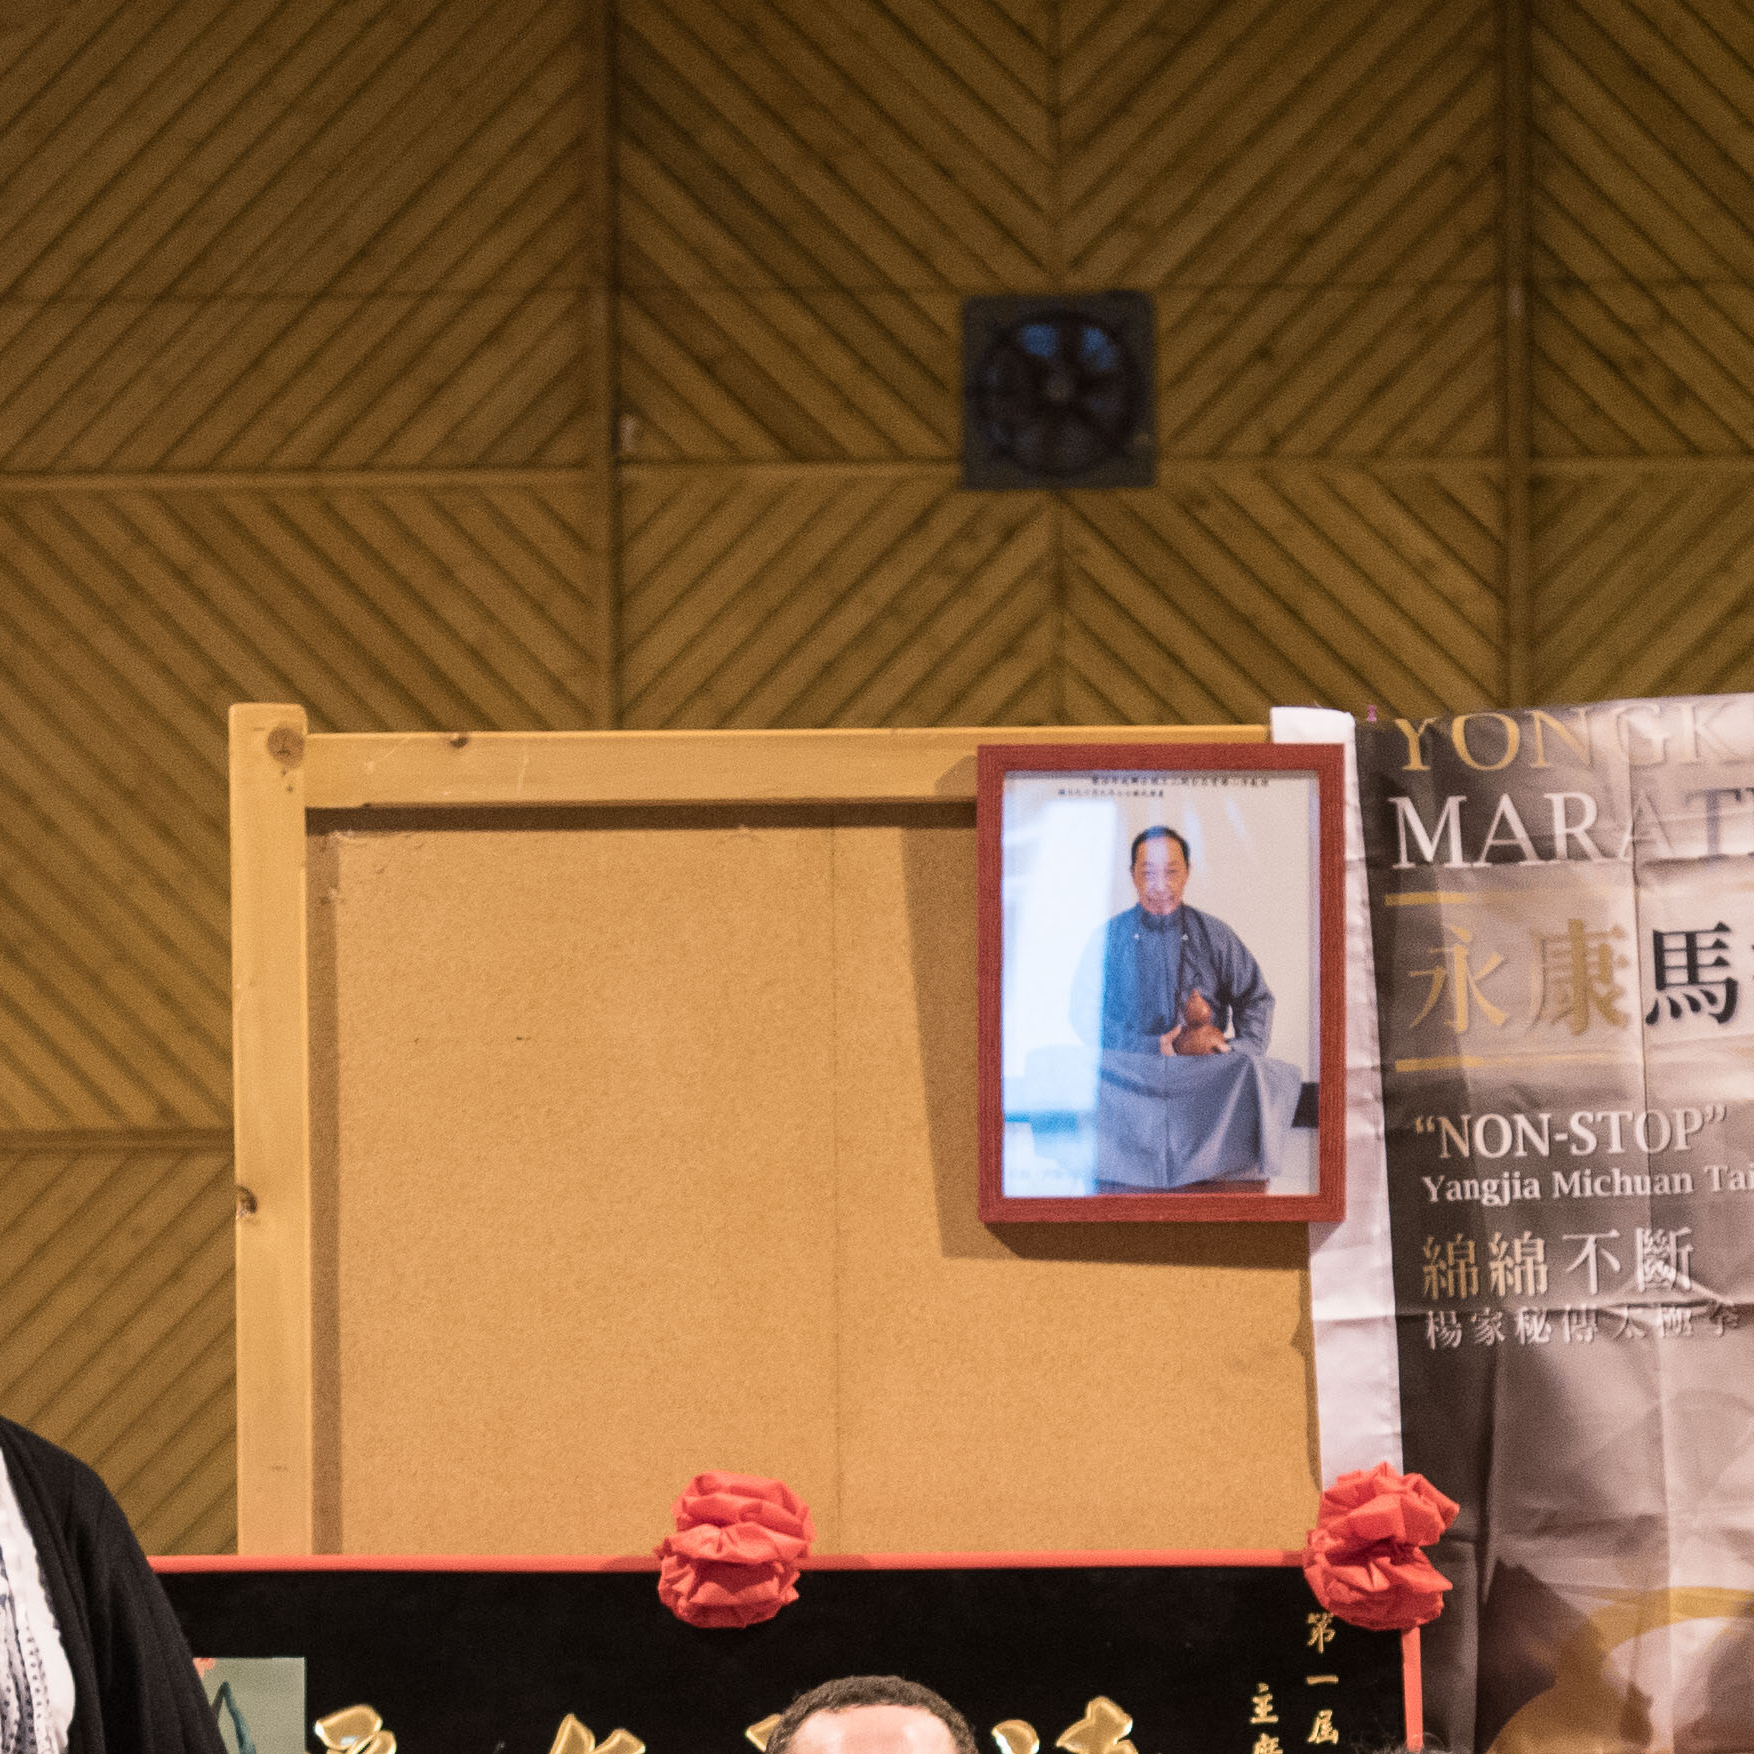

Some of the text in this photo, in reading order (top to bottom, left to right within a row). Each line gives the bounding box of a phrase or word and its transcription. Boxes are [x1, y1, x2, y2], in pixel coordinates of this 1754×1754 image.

[1421, 1171, 1541, 1207] Yangjia
[1552, 1168, 1694, 1198] Michuan
[1422, 1226, 1694, 1300] 綿綿不斷
